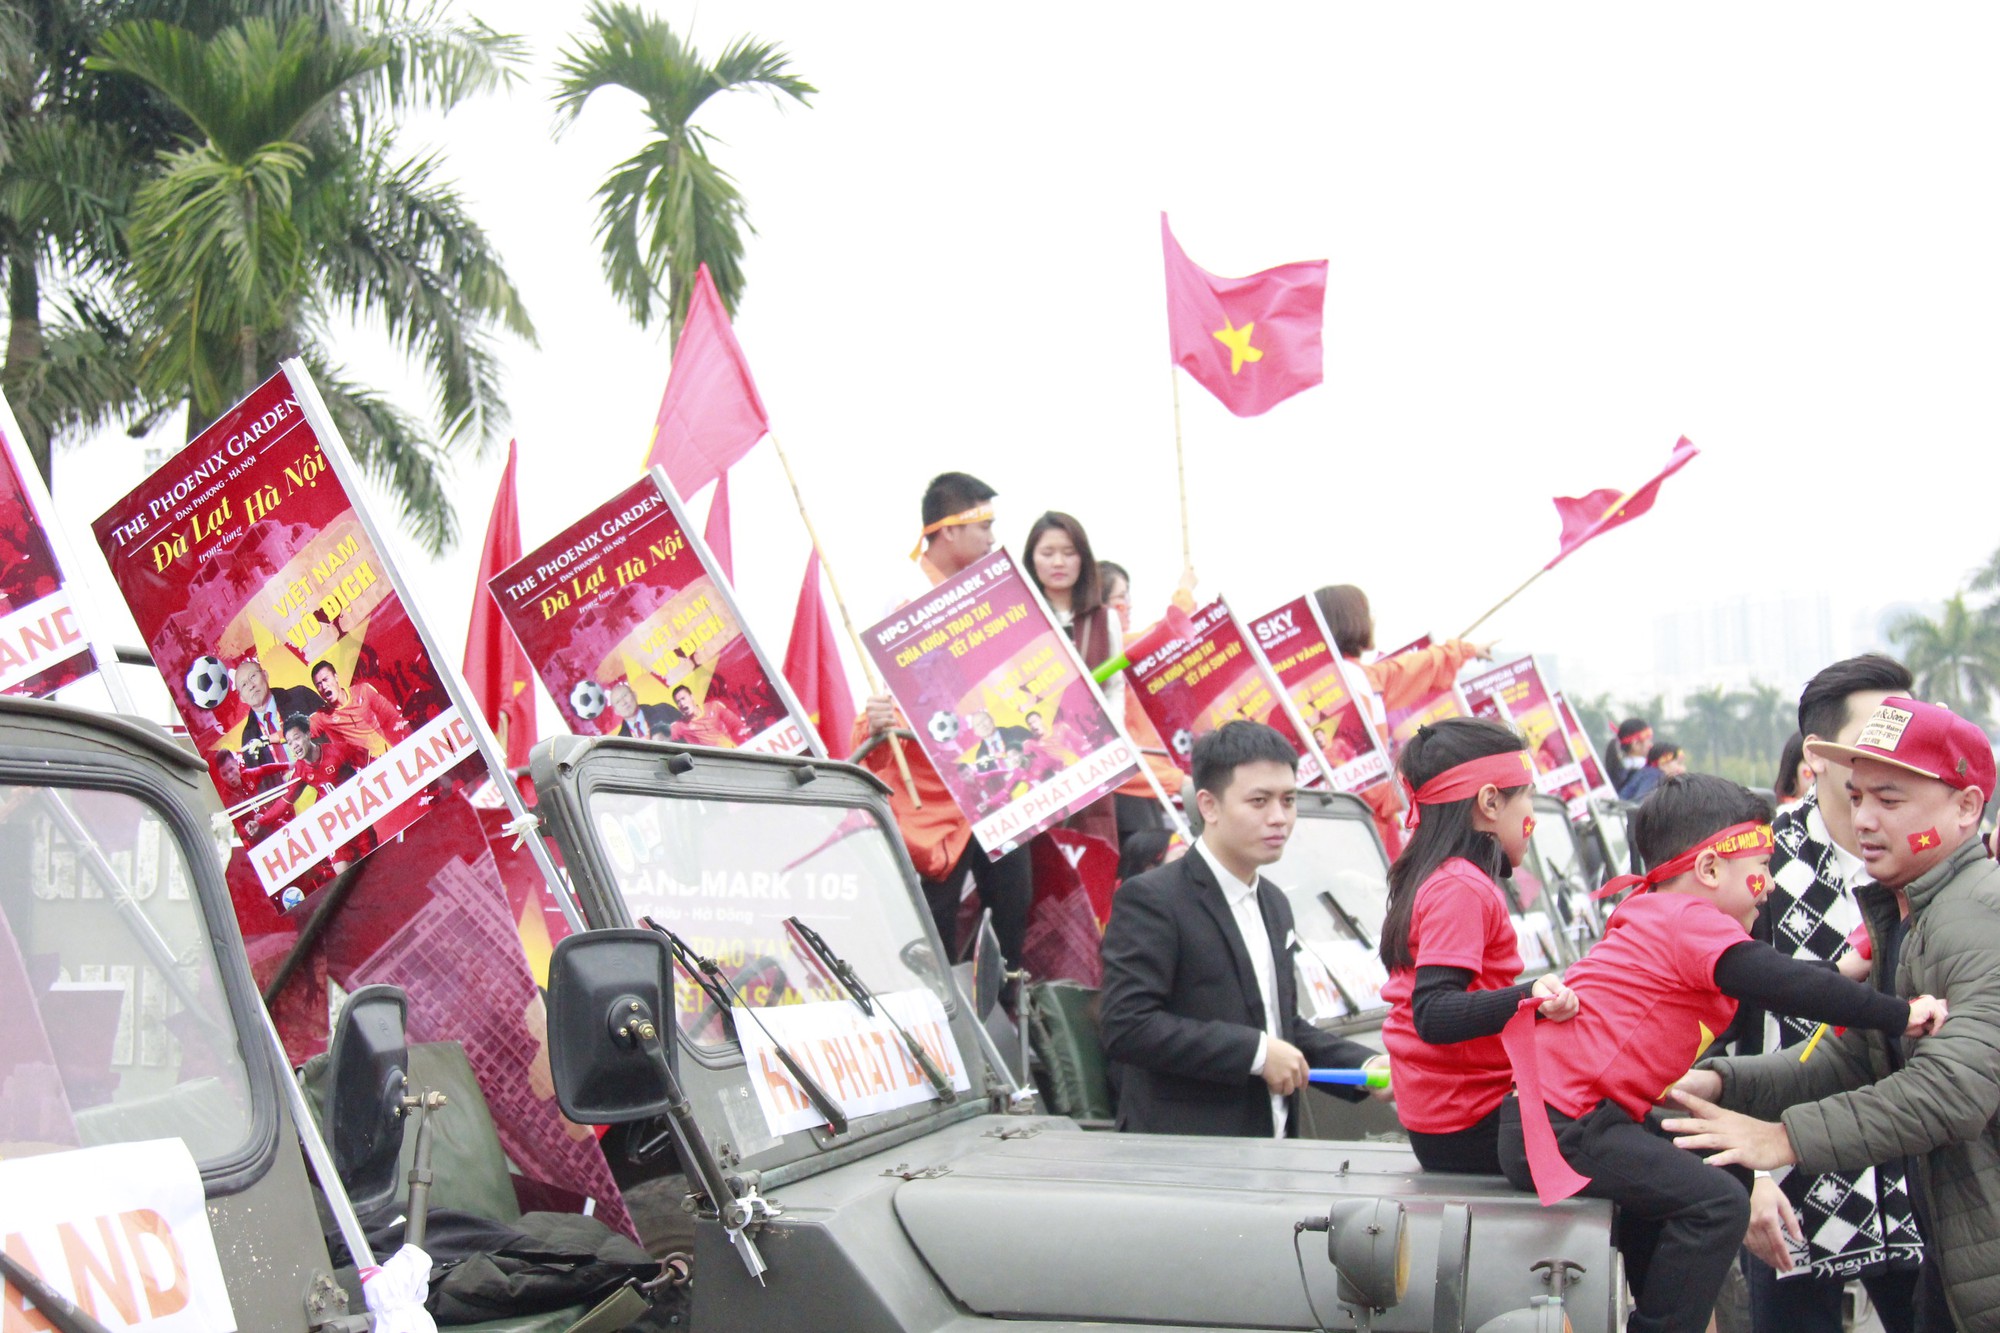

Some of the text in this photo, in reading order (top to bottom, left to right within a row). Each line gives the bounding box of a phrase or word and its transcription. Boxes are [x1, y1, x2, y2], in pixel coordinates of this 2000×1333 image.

[111, 512, 149, 547] THE
[149, 450, 228, 519] PHOENIX
[151, 445, 326, 573] Đà Lạt Hà Nội
[272, 534, 360, 618] VIỆT NAM
[506, 491, 665, 601] THE PHOENIX GARDEN
[541, 529, 684, 621] Đà Lạt Hà Nội
[287, 560, 377, 649] VÔ ĐỊCH
[672, 594, 710, 631] NAM
[908, 574, 985, 627] LANDMARK
[983, 558, 1011, 581] 105
[971, 601, 992, 622] TAY
[1255, 609, 1294, 641] SKY
[262, 827, 317, 882] HẢI
[317, 770, 394, 842] PHÁT
[396, 717, 474, 787] LAND
[804, 871, 859, 901] 105
